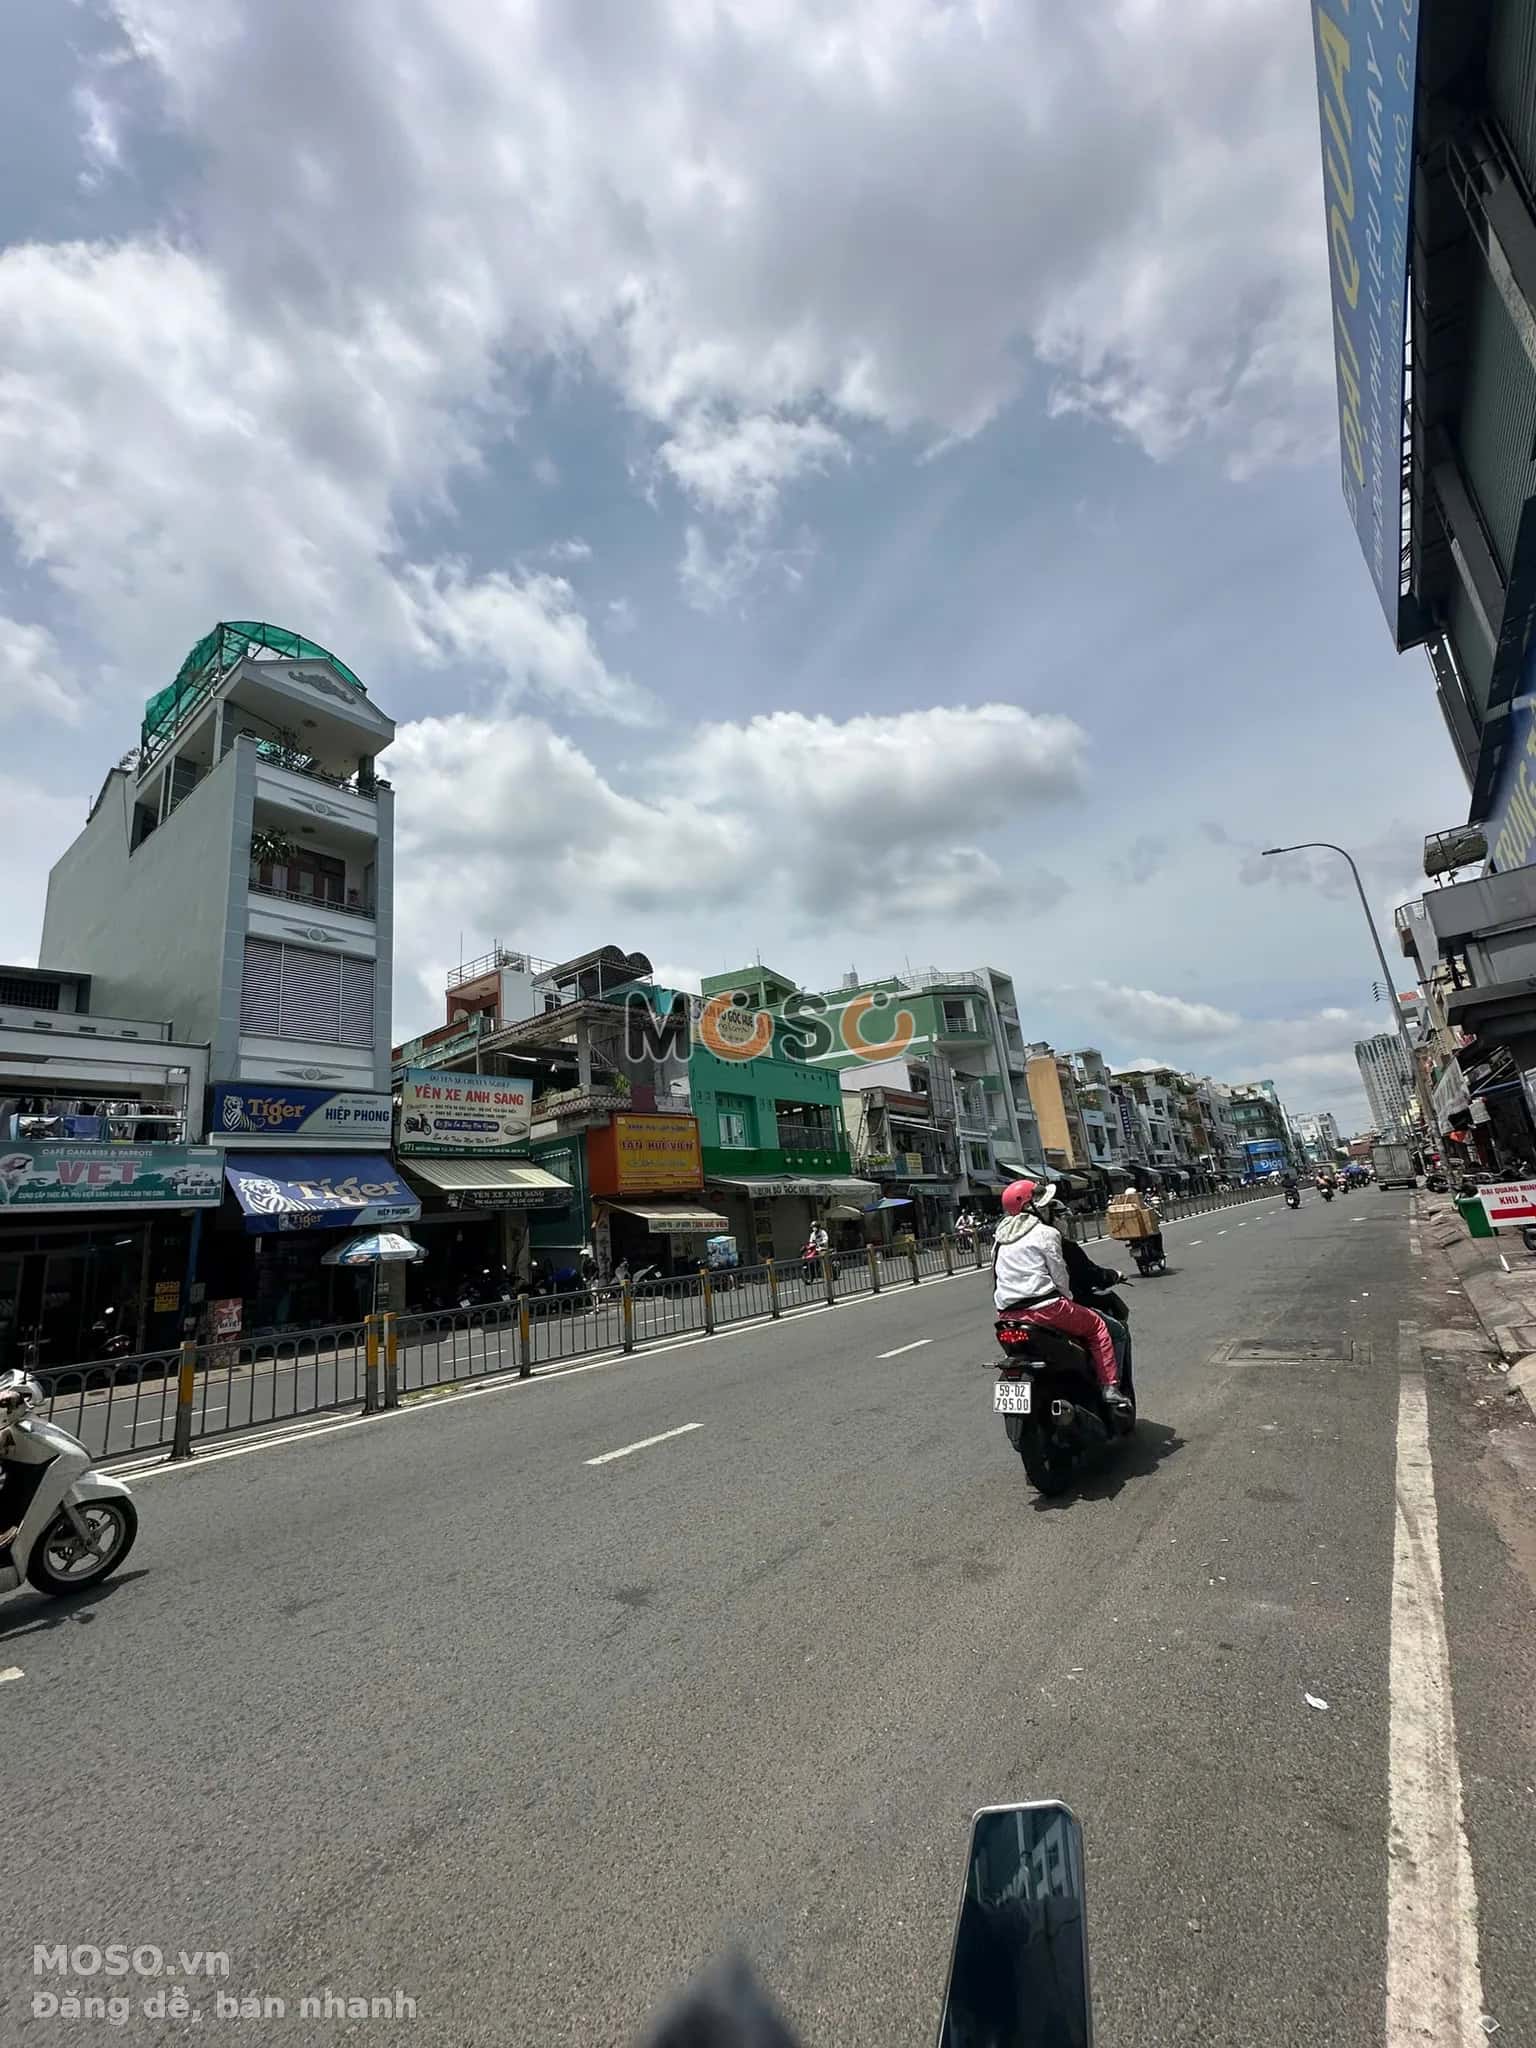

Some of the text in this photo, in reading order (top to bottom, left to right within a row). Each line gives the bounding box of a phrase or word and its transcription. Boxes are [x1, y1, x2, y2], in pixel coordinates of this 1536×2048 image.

[1396, 52, 1410, 91] P.
[1367, 32, 1383, 195] MAY
[1319, 0, 1368, 487] ĐẠI QUA
[1366, 192, 1384, 318] LIỆU
[1369, 313, 1384, 411] PHỤ
[1371, 403, 1383, 526] DOANH
[248, 1097, 306, 1124] Tiger
[415, 1083, 524, 1106] YÊN XE ANH SANG
[325, 1105, 390, 1124] HIỆP PHONG
[288, 1177, 400, 1205] Tiger
[1499, 1194, 1528, 1204] KHU A
[290, 1212, 323, 1228] Tiger
